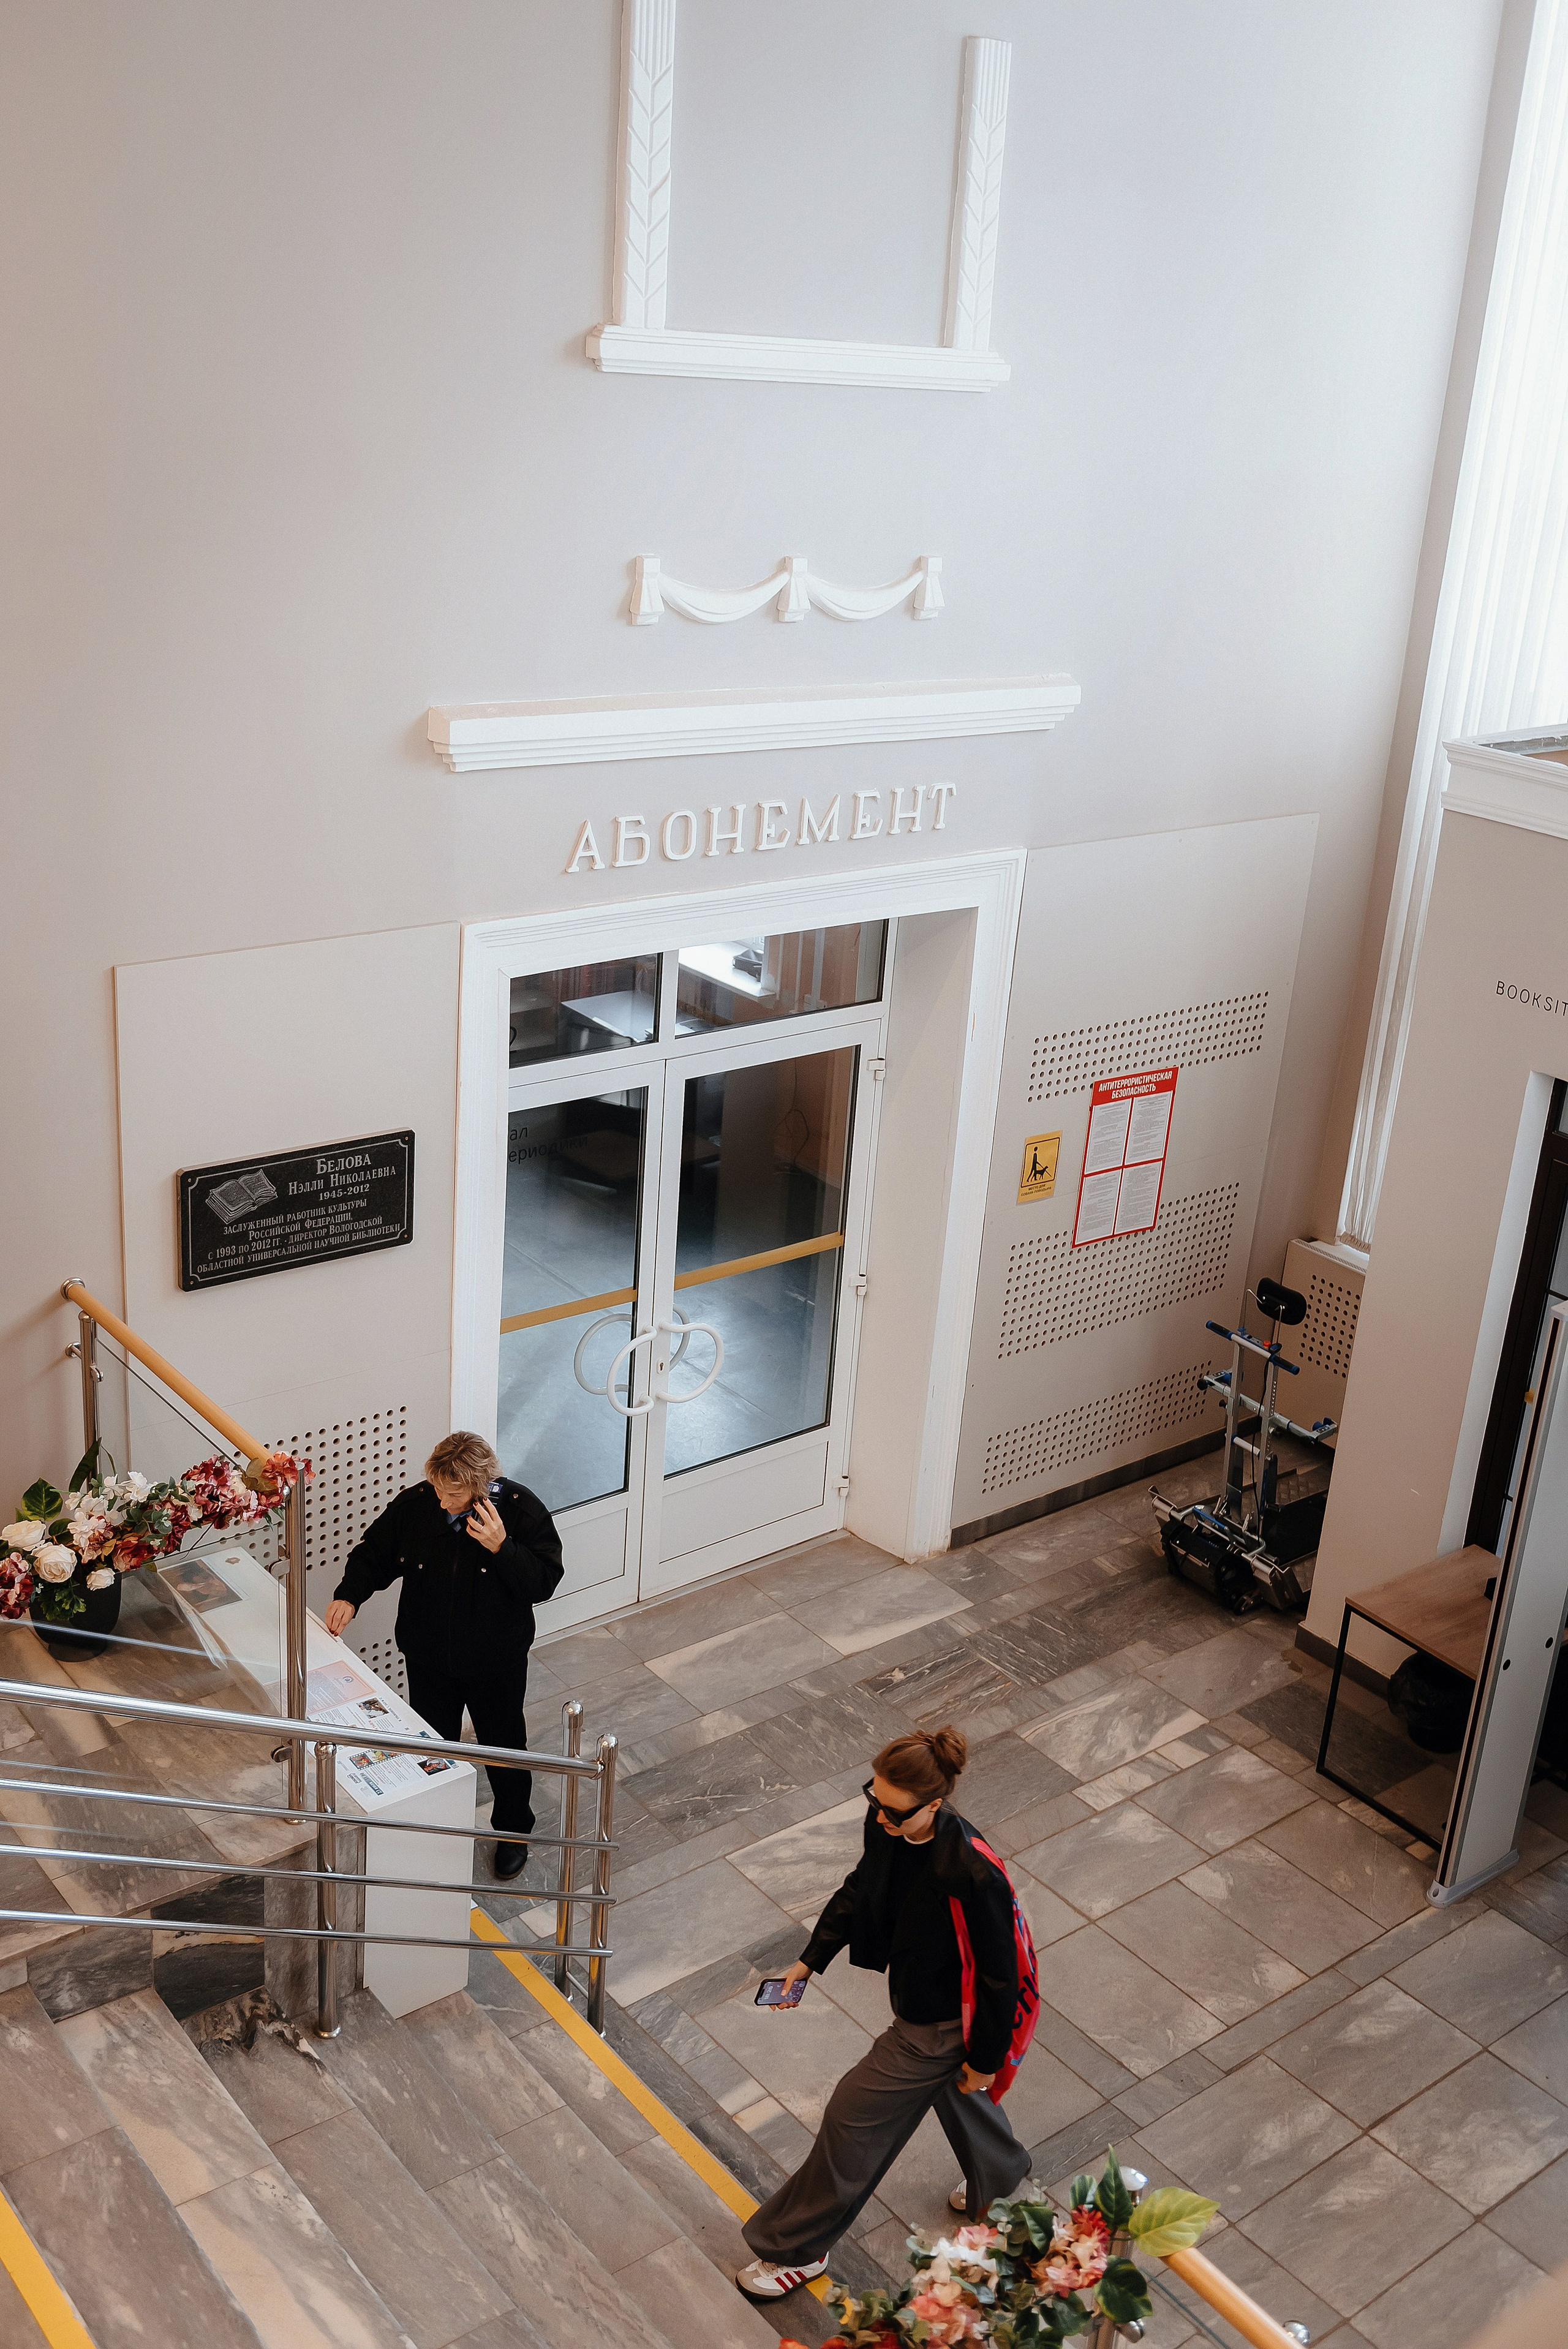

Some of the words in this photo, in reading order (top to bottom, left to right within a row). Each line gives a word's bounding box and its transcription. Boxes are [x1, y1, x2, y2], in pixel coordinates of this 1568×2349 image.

[564, 782, 957, 873] АБОНЕМЕНТ
[1098, 1070, 1173, 1092] АНТИТЕРРОРИСТИЧЕСКАЯ
[1111, 1083, 1156, 1099] БЕЗОПАСНОСТЬ
[509, 1126, 529, 1141] ал
[508, 1136, 588, 1165] ериодики
[316, 1153, 372, 1175] БЕЛОВА
[288, 1179, 324, 1195] НЭЛЛИ
[330, 1166, 396, 1187] НИКОЛАЕВНА
[318, 1183, 370, 1201] 1945-2012
[223, 1213, 284, 1235] ЗАСЛУЖЕННЫЙ
[287, 1207, 326, 1222] РАБОТНИК
[328, 1198, 368, 1214] КУЛЬТУРЫ
[216, 1245, 236, 1259] 1993
[239, 1245, 249, 1254] ПО
[251, 1239, 271, 1251] 2012
[288, 1228, 327, 1245] ДИРЕКТОР
[330, 1215, 382, 1235] ВОЛОГОДСКОЙ
[248, 1221, 301, 1241] РОССИЙСКОЙ
[197, 1255, 244, 1273] ОБЛАСТНОЙ
[247, 1241, 312, 1263] УНИВЕРСАЛЬНОЙ
[314, 1232, 350, 1248] НАУЧНОЙ
[352, 1223, 400, 1241] БИБЛИОТЕКИ
